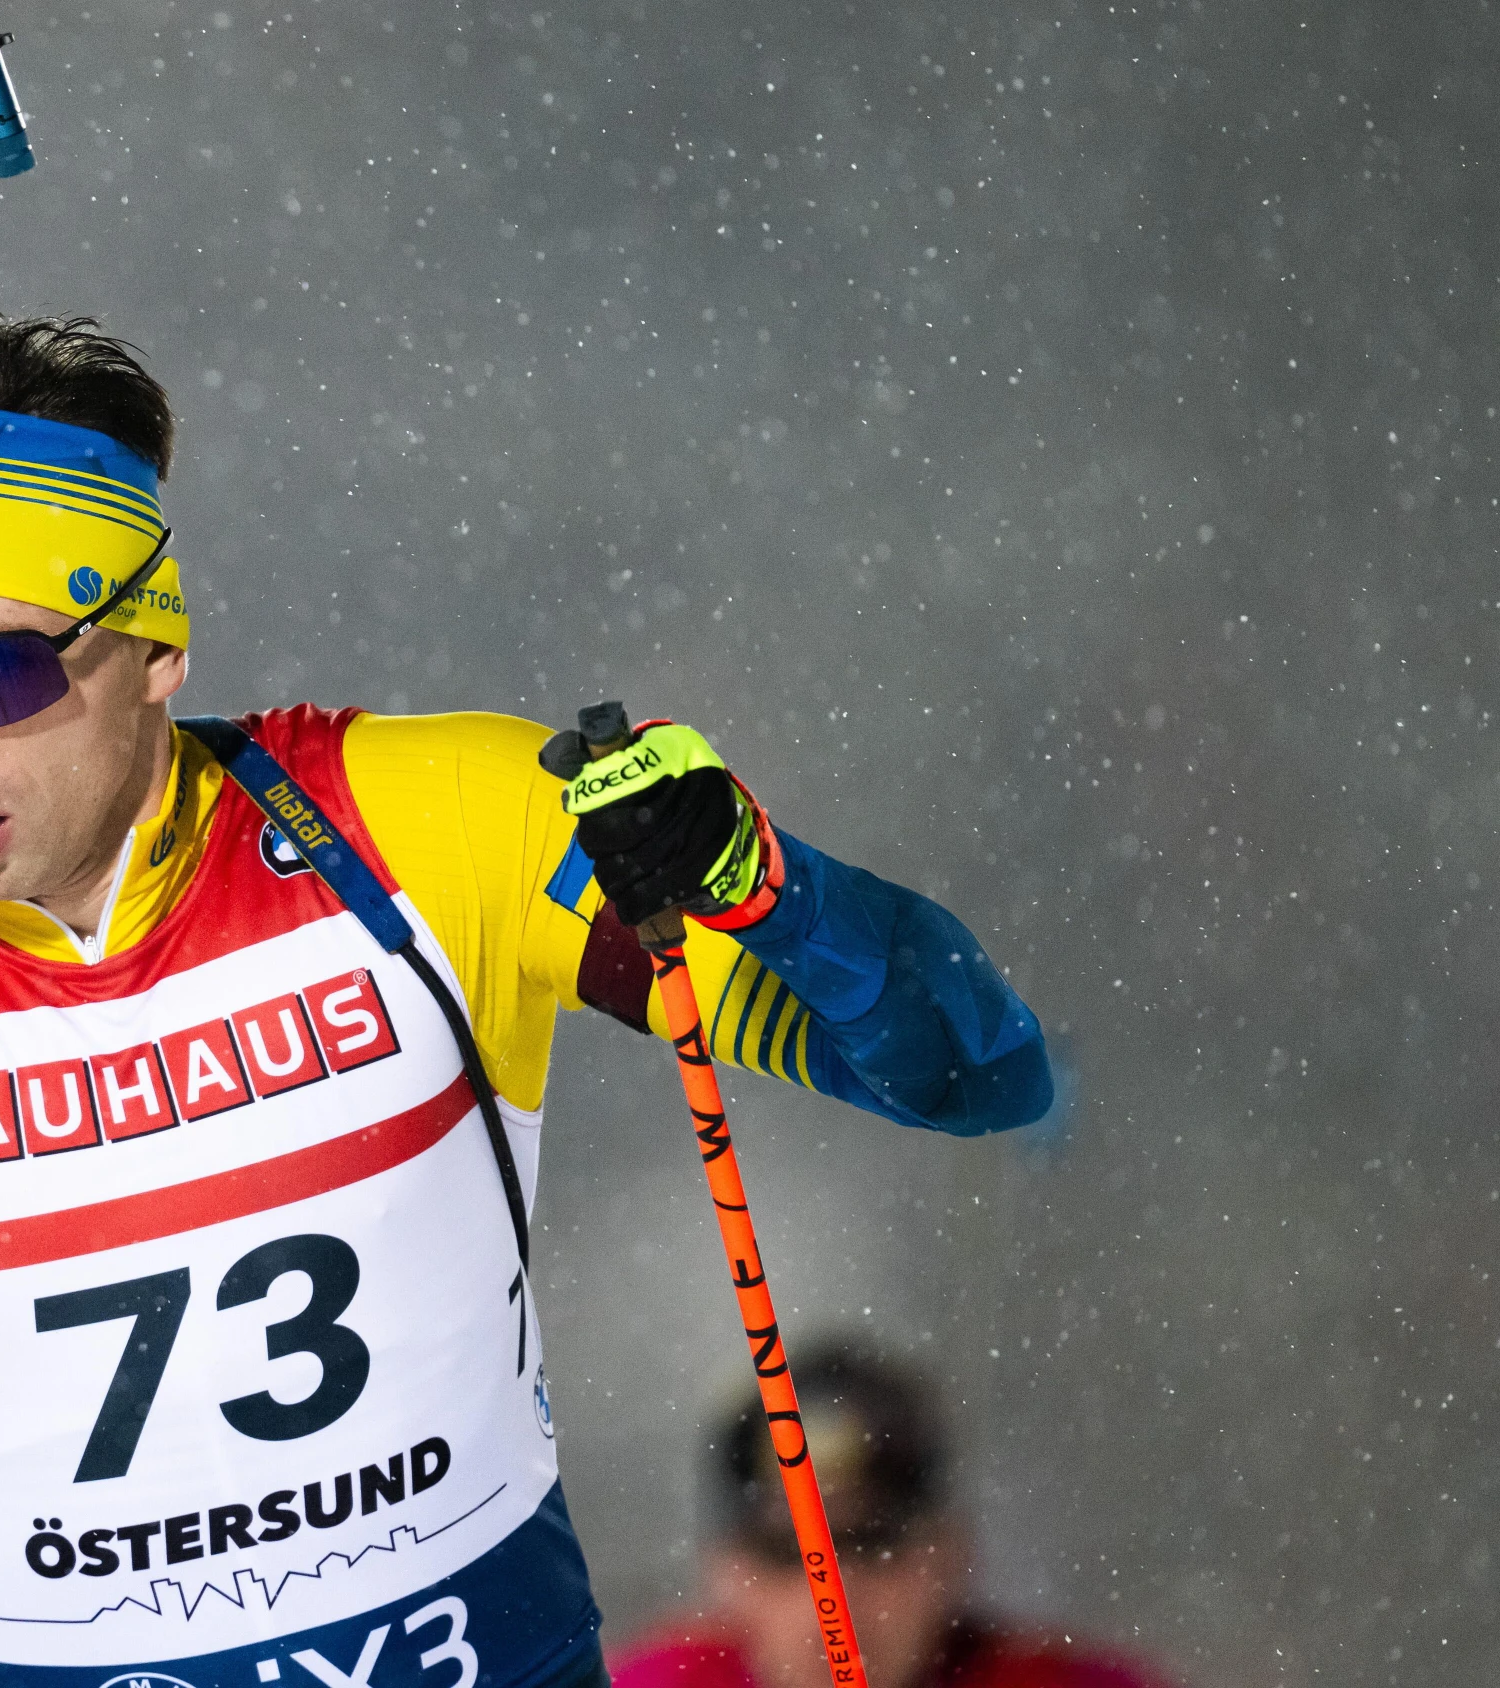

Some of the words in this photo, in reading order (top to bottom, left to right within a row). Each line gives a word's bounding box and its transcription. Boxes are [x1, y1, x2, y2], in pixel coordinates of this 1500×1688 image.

[33, 1233, 371, 1483] 73
[24, 1435, 452, 1580] ÖSTERSUND
[806, 1552, 828, 1583] 40
[818, 1598, 854, 1688] REMIO
